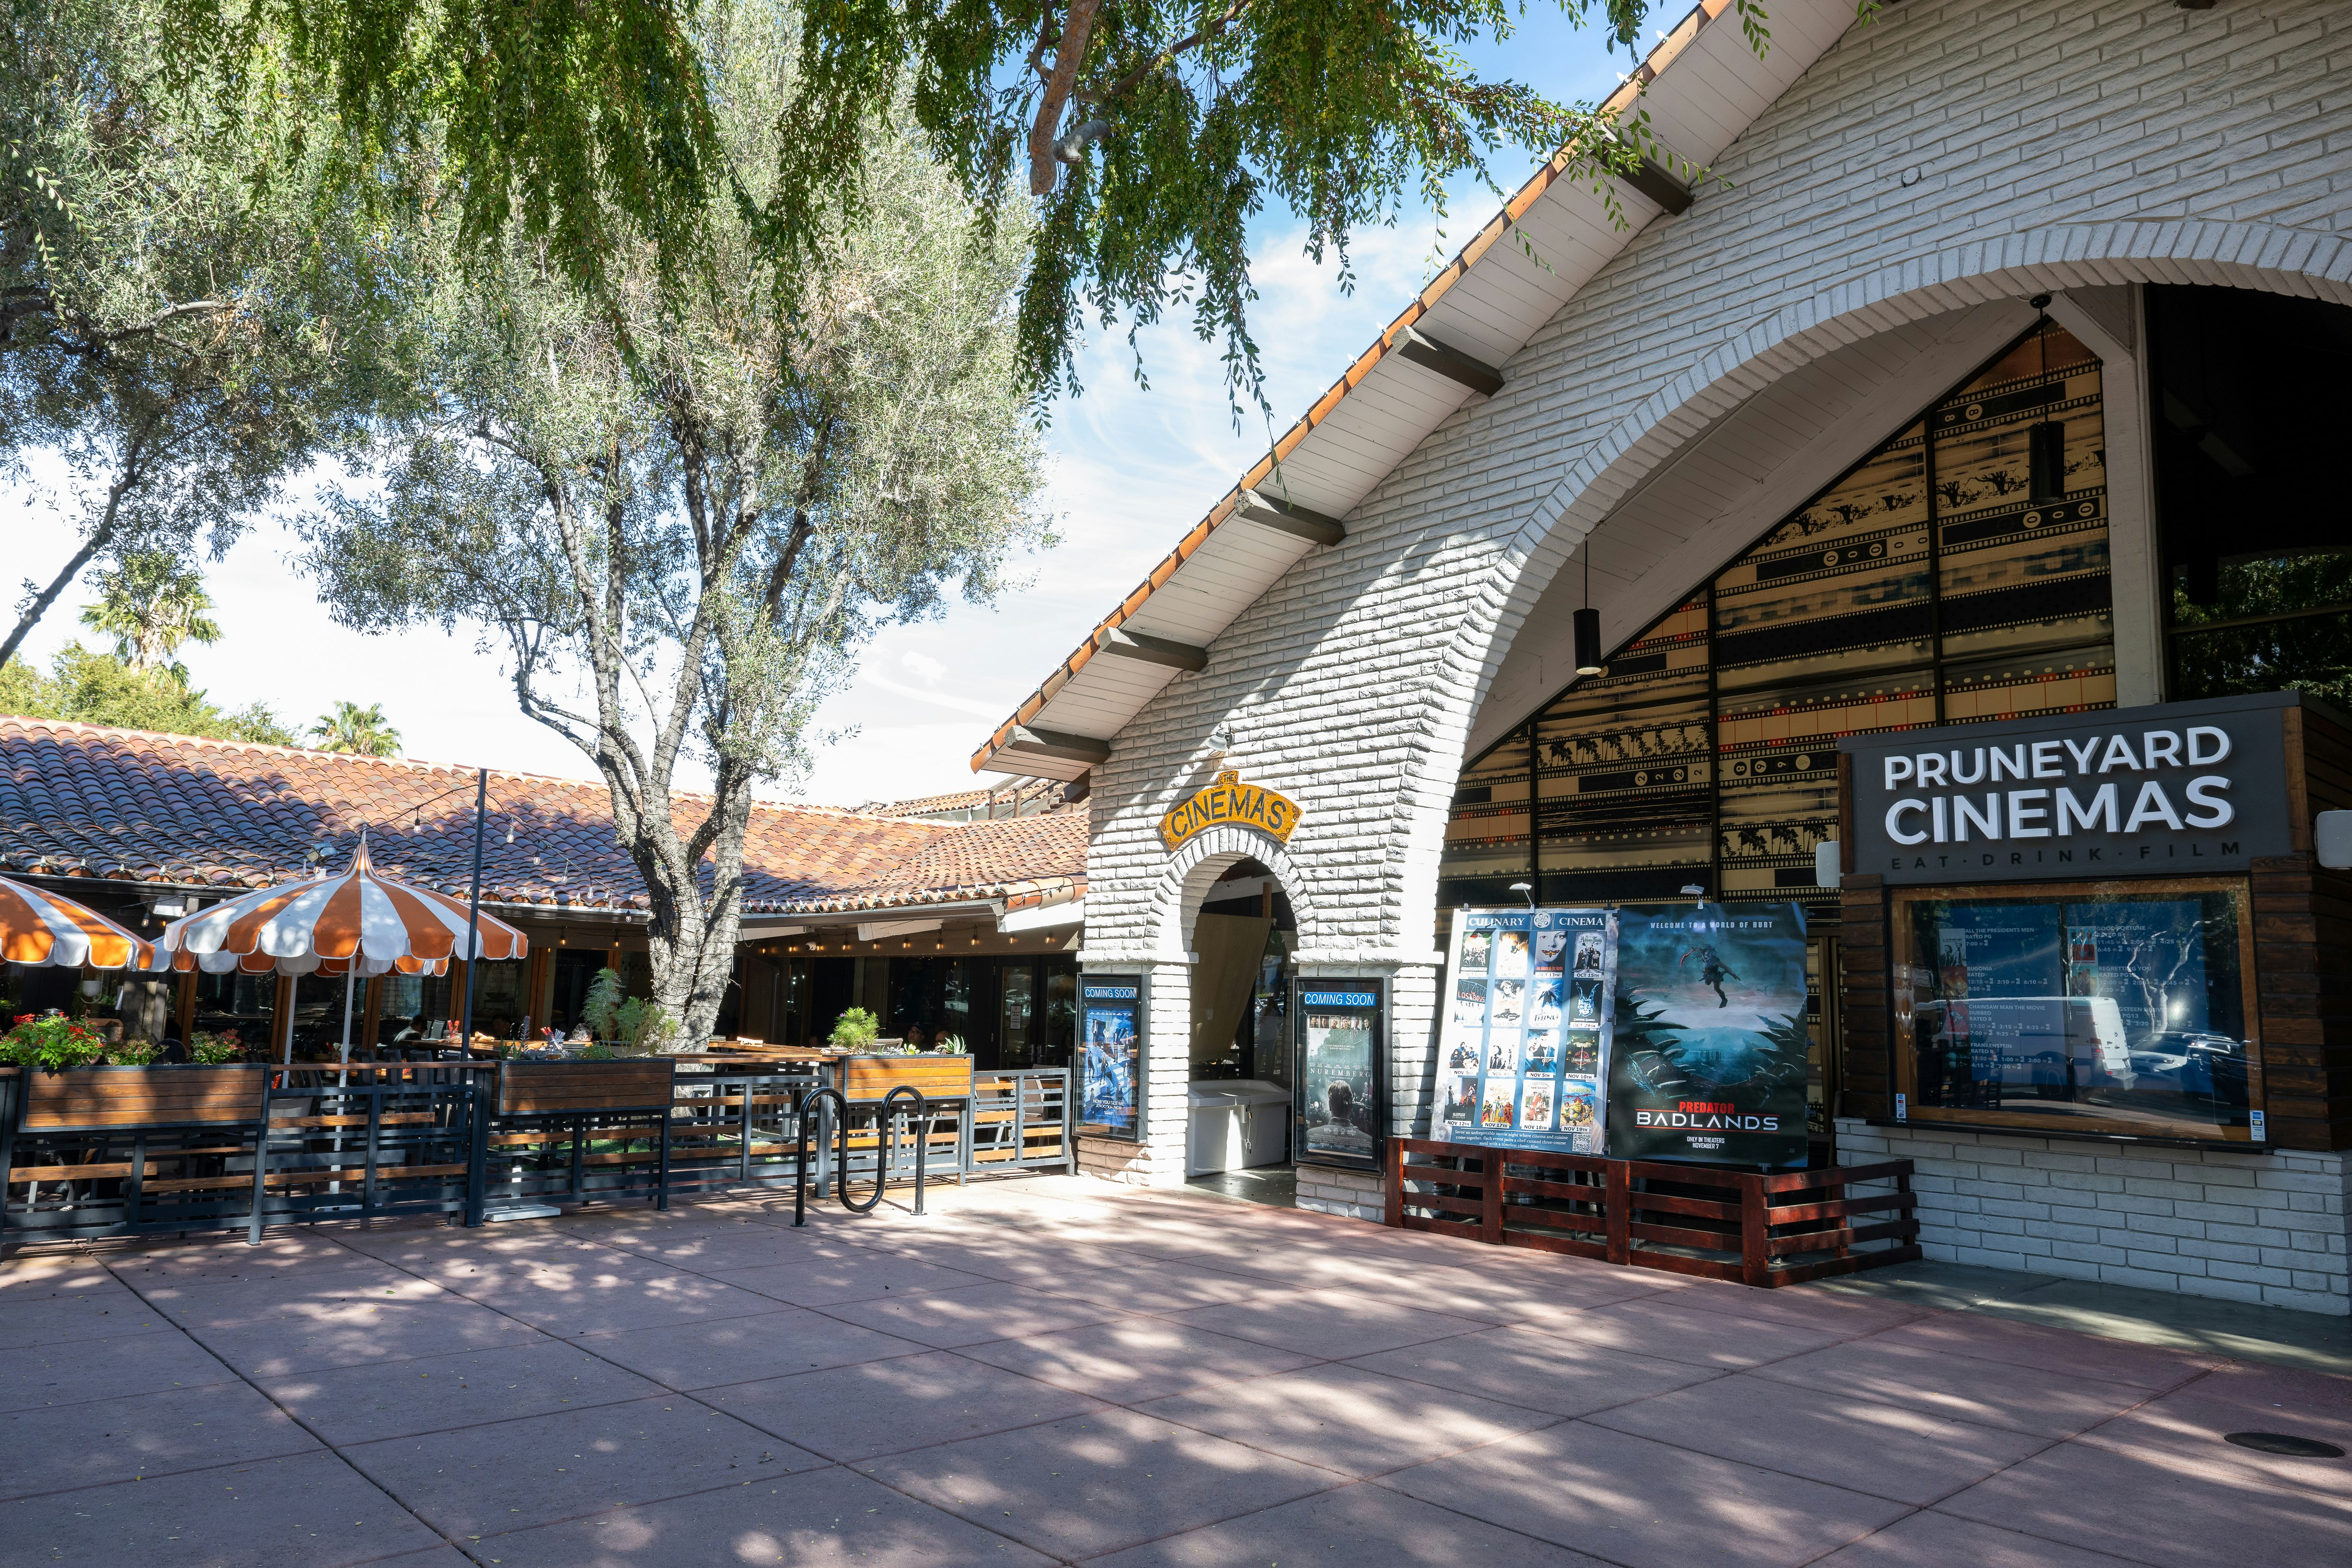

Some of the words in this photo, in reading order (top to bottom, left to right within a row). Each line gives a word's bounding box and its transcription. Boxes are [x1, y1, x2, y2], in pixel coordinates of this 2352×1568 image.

[1885, 726, 2232, 790] PRUNEYARD
[1223, 773, 1234, 782] THE
[1171, 789, 1286, 837] CINEMAS
[1885, 776, 2235, 845] CINEMAS
[1892, 856, 1950, 870] EAT
[1983, 848, 2102, 867] DRINK
[2140, 842, 2239, 859] FILM
[1468, 917, 1525, 926] CULINARY
[1559, 917, 1604, 926] CINEMA
[1085, 989, 1113, 997] COMING
[1114, 989, 1135, 998] SOON
[1305, 994, 1343, 1004] COMING
[1345, 994, 1374, 1005] SOON
[1458, 991, 1472, 1000] LOST
[1310, 1068, 1371, 1077] NUREMBERG
[1679, 1101, 1734, 1114] PREDATOR
[1636, 1112, 1778, 1131] BADLANDS
